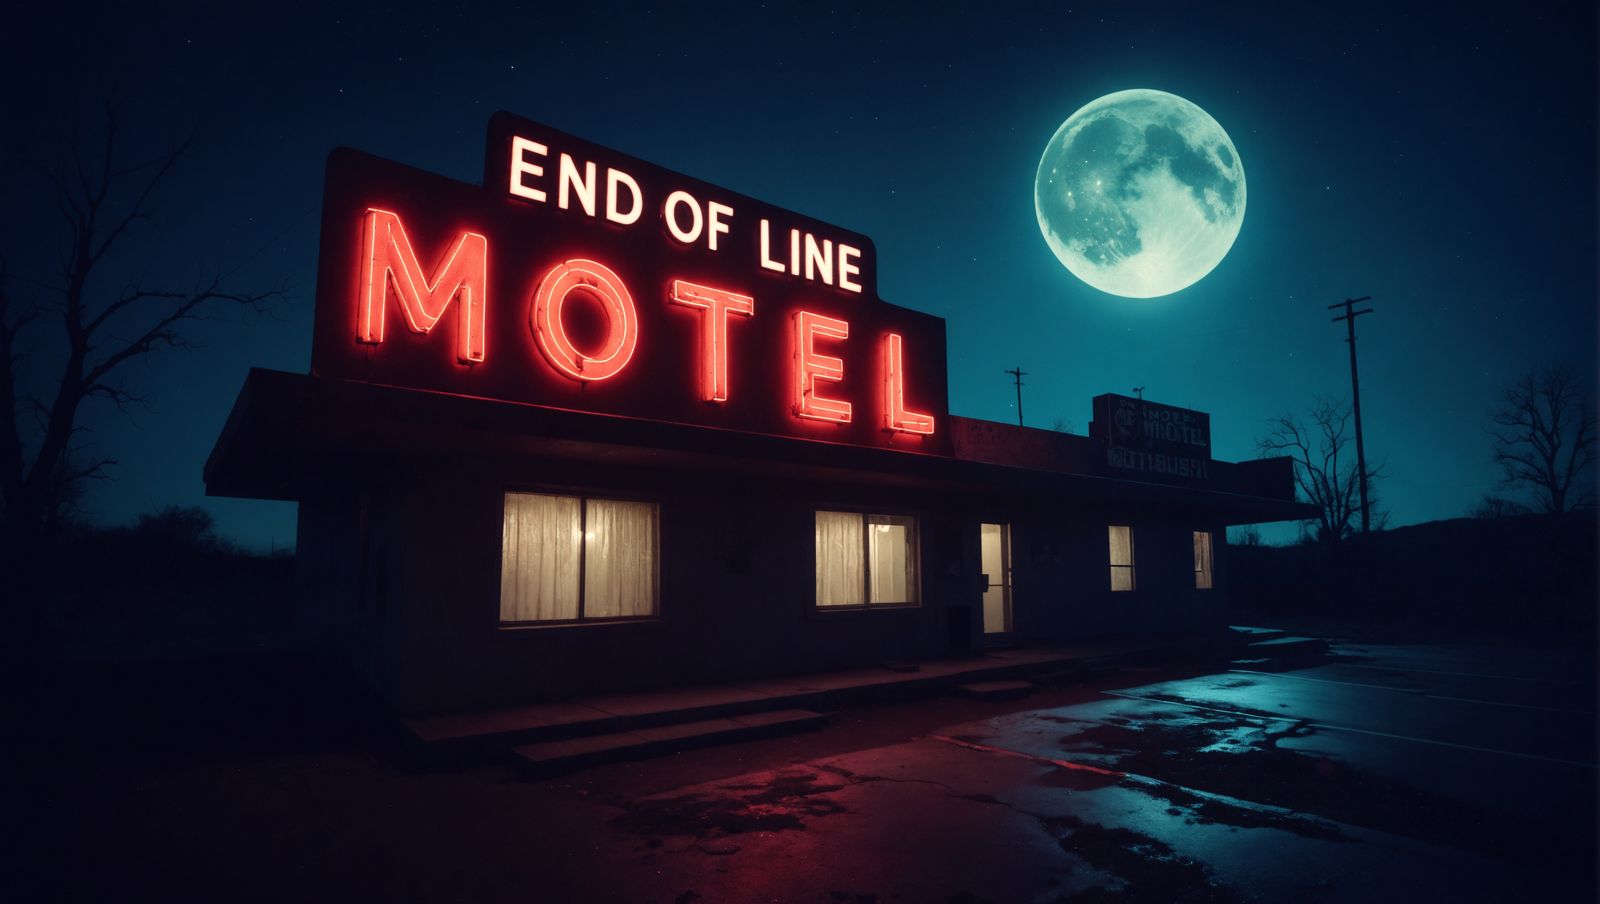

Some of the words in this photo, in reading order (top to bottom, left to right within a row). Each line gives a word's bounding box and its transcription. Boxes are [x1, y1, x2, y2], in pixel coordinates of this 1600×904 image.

[509, 135, 643, 225] END
[664, 190, 734, 251] OF
[760, 219, 862, 293] LINE
[356, 207, 935, 435] MOTEL
